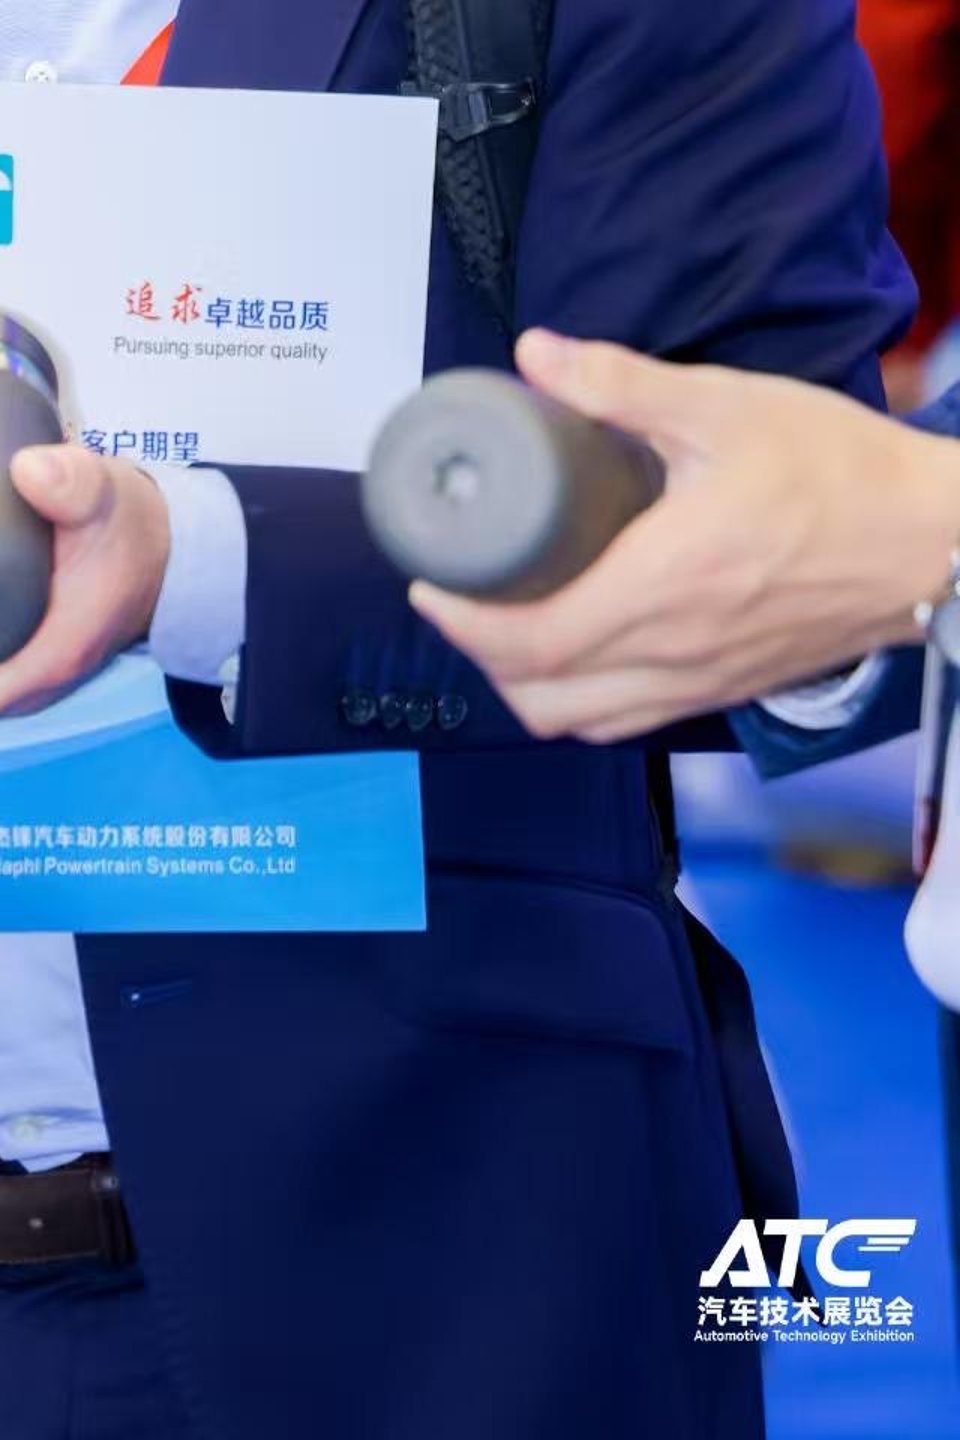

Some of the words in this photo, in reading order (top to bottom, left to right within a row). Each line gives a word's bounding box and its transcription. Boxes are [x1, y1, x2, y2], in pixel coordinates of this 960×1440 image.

[114, 336, 189, 359] Pursuing
[194, 340, 265, 359] superior
[270, 343, 328, 363] quality
[146, 856, 224, 877] Systems
